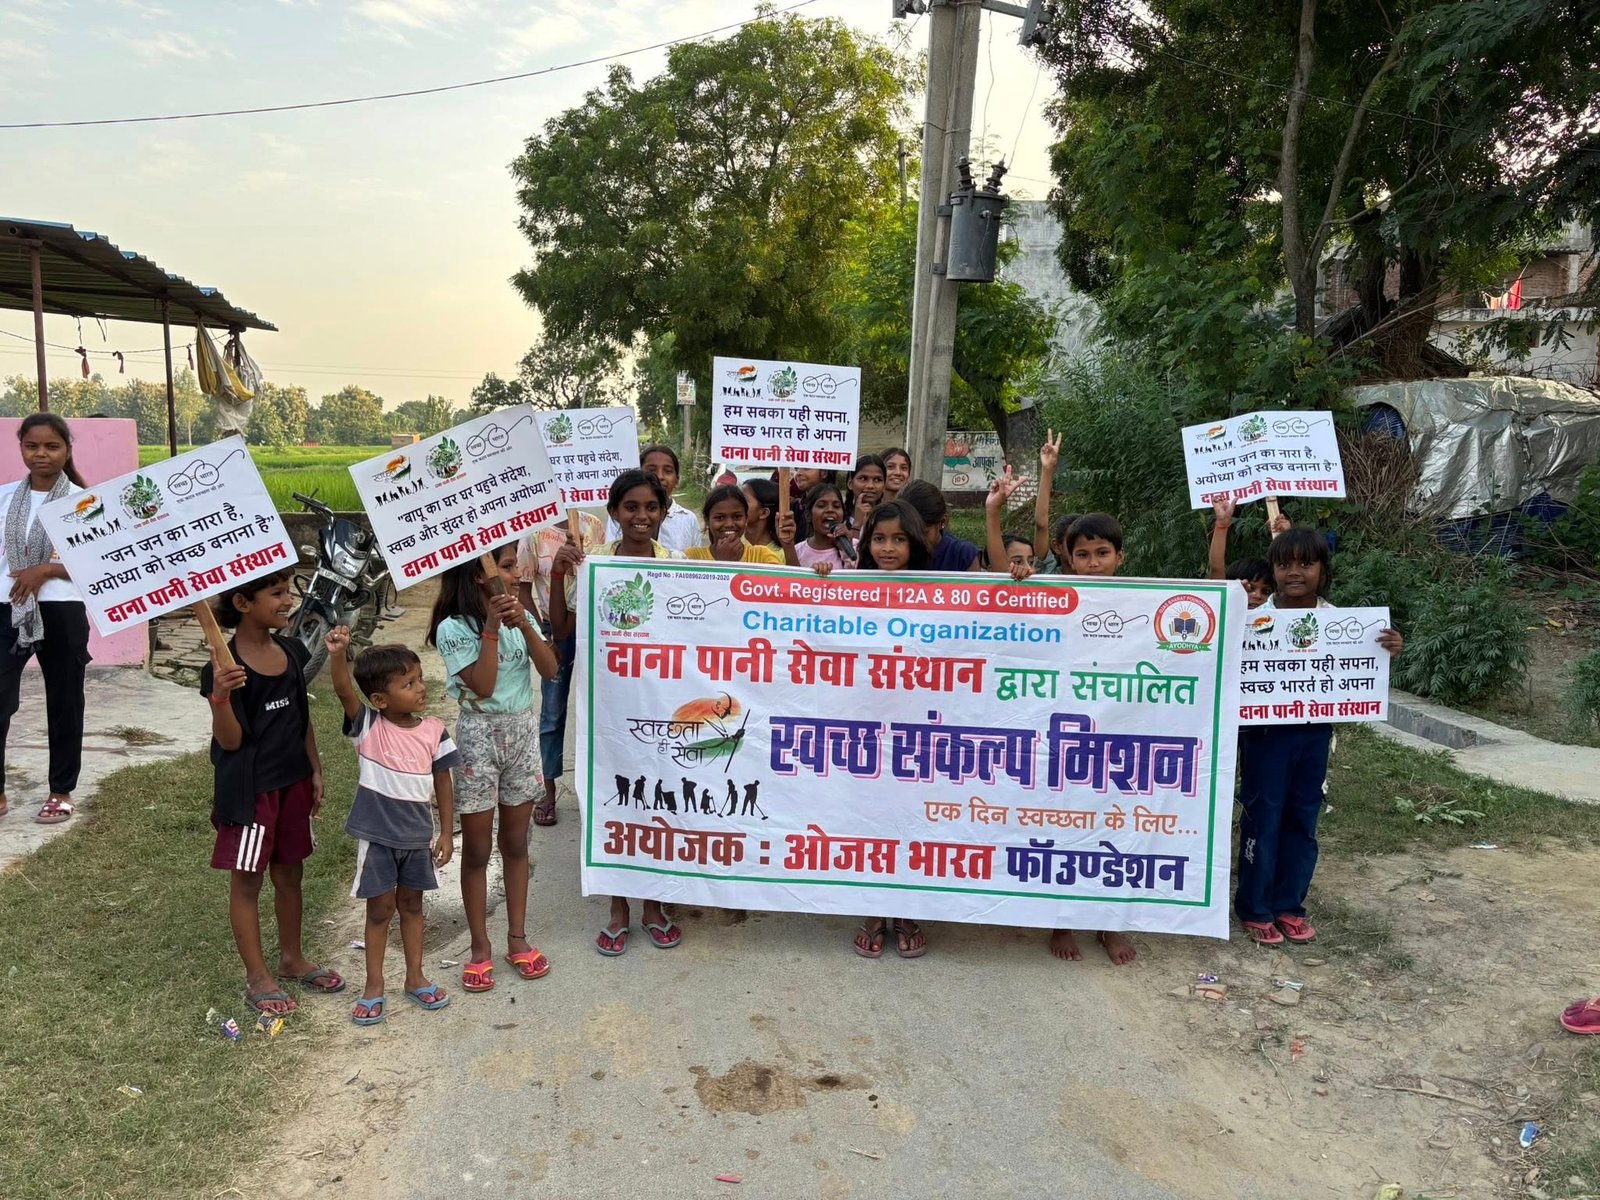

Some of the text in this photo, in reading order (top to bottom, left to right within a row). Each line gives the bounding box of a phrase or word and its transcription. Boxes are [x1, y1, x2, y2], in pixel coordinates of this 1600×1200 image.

[724, 405, 850, 426] हम सबका यही सपना,
[723, 424, 846, 442] स्वच्छ भारत हो अपना
[563, 455, 575, 464] घर
[721, 445, 851, 465] दाना पानी सेवा संस्थान
[1238, 452, 1257, 463] जन
[1260, 449, 1276, 458] का
[1279, 449, 1301, 459] नारा
[564, 469, 574, 482] हो
[576, 470, 599, 480] अपना
[1195, 472, 1234, 486] अयोध्या
[1238, 465, 1252, 478] को
[1255, 463, 1284, 473] स्वच्छ
[1265, 477, 1292, 491] सेवा
[1294, 477, 1338, 491] संस्थान
[425, 501, 442, 515] का
[442, 494, 458, 508] घर
[459, 487, 474, 501] घर
[474, 474, 498, 495] पहुचे
[498, 465, 531, 485] संदेश,
[570, 487, 594, 502] सेवा
[136, 532, 163, 551] जन
[164, 524, 188, 542] का
[188, 511, 224, 531] नारा
[223, 502, 244, 521] है,
[387, 534, 416, 555] स्वच्छ
[419, 523, 439, 542] और
[440, 513, 465, 536] सुंदर
[466, 507, 478, 524] हो
[480, 498, 508, 516] अपना
[509, 482, 548, 504] अयोध्या
[402, 502, 558, 578] दाना पानी सेवा संस्थान
[88, 567, 142, 596] अयोध्या
[142, 554, 166, 575] को
[166, 542, 206, 567] स्वच्छ
[208, 523, 255, 549] बनाना
[104, 542, 288, 623] दाना पानी सेवा संस्थान
[647, 571, 661, 579] Regd
[739, 580, 785, 599] Govt.
[789, 582, 881, 604] Registered
[896, 587, 930, 604] 12A
[933, 588, 948, 605] &
[951, 589, 971, 606] 80
[976, 589, 990, 606] G
[995, 590, 1070, 609] Certified
[742, 610, 1062, 643] Charitable Organization
[1168, 642, 1199, 650] AYODHYA
[605, 637, 1199, 705] दाना पानी सेवा संस्थान द्वारा संचालित
[1241, 654, 1379, 675] हम सबका यही सपना,
[1240, 680, 1276, 694] स्वच्छ
[1320, 674, 1334, 693] हो
[1338, 677, 1375, 691] अपना
[1240, 699, 1382, 720] दाना पानी सेवा संस्थान
[626, 718, 705, 745] स्वच्छता
[657, 738, 707, 769] ही सेवा
[769, 710, 1203, 797] स्वच्छ संकल्प मिशन
[924, 801, 962, 822] एक
[969, 796, 1009, 825] दिन
[1017, 807, 1096, 830] स्वच्छता
[1104, 804, 1126, 831] के
[604, 816, 747, 866] अयोजक
[784, 824, 900, 874] ओजस
[908, 840, 996, 880] भारत
[1005, 838, 1190, 891] फॉउण्डेशन
